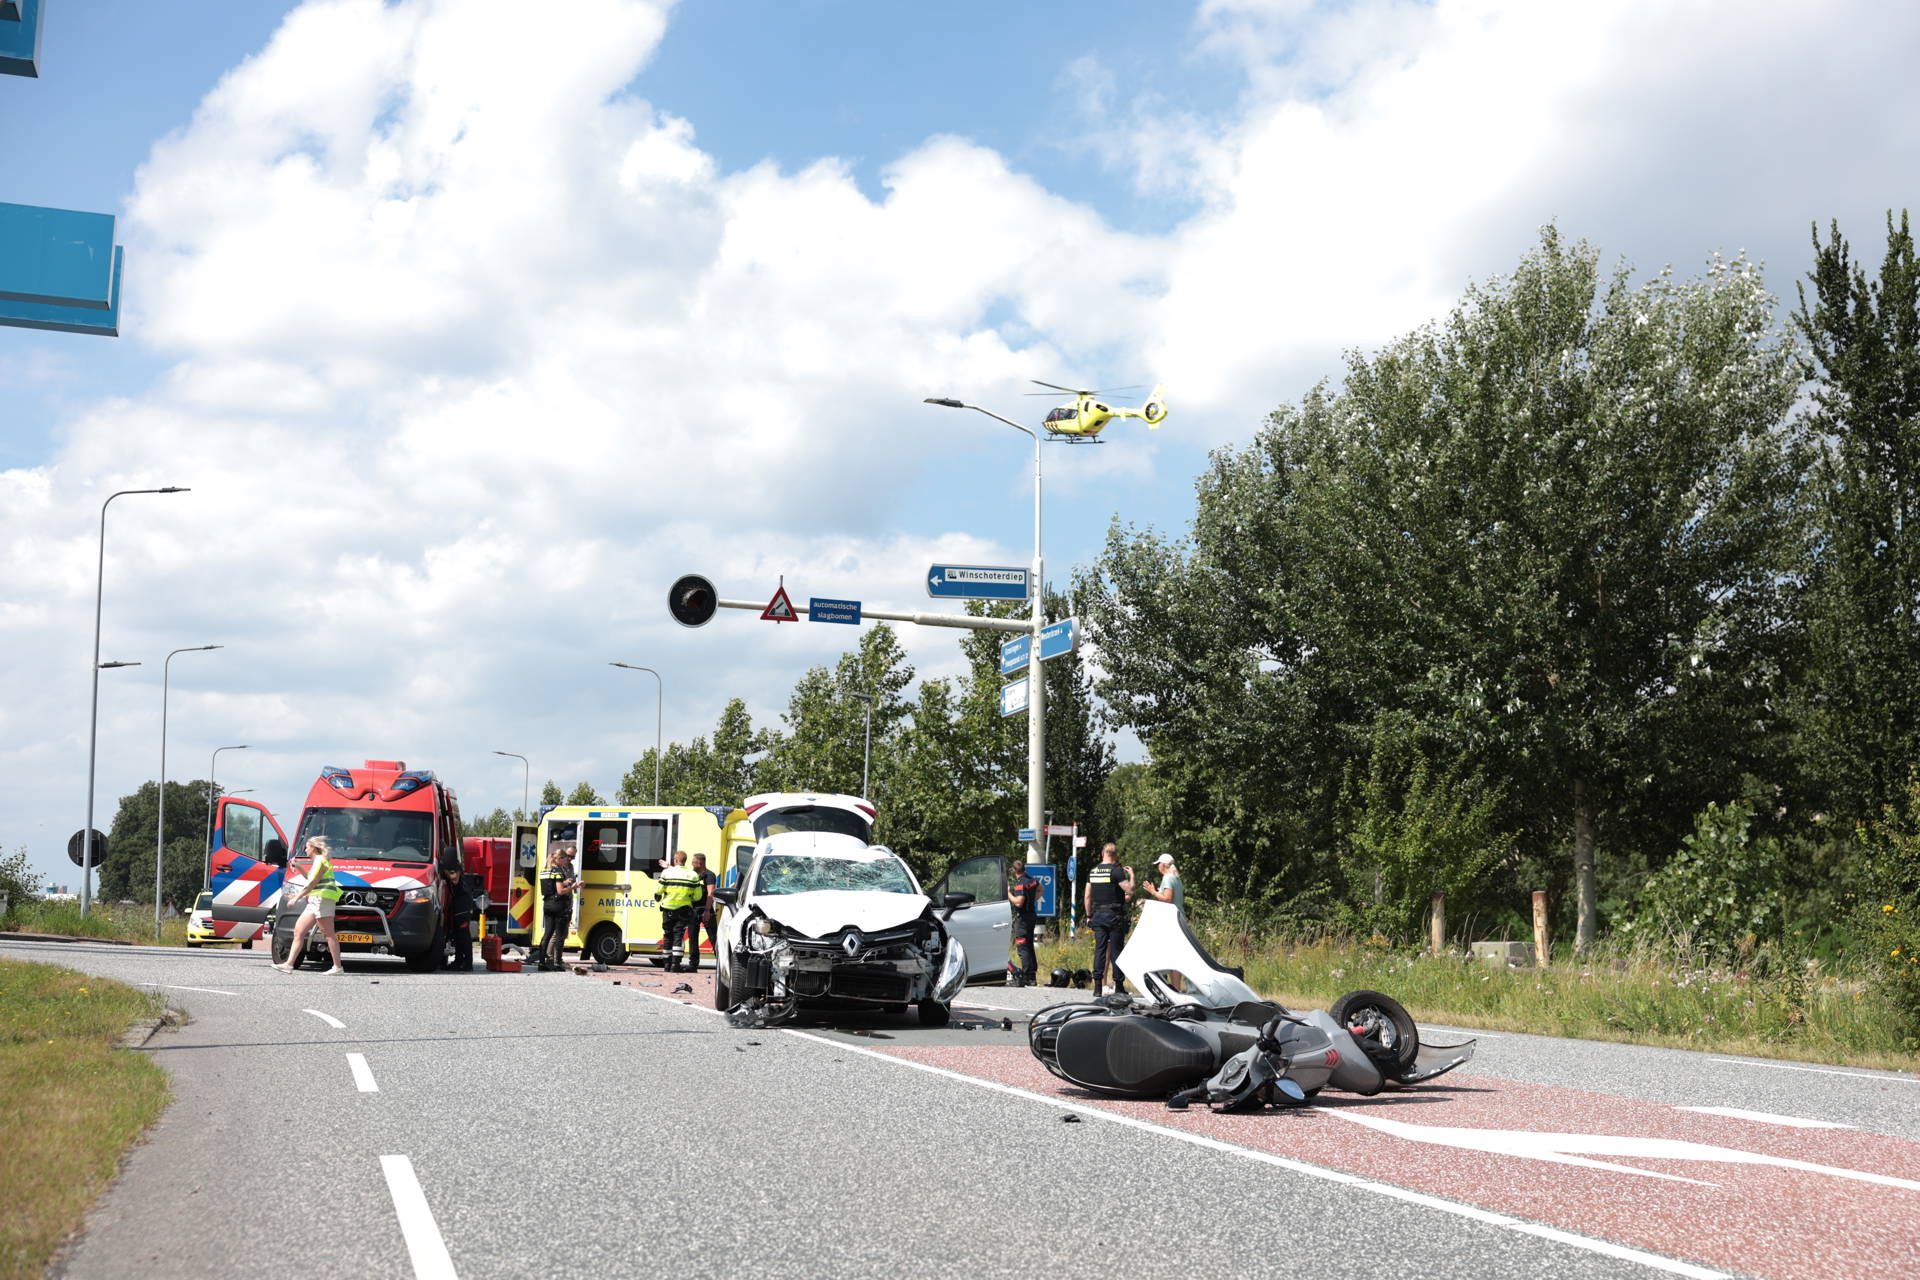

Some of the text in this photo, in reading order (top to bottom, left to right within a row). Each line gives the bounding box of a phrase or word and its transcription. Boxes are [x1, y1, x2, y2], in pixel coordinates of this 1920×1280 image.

[959, 570, 1023, 581] Winschoterdiep
[813, 602, 858, 611] automatische
[817, 611, 853, 621] slagbomen
